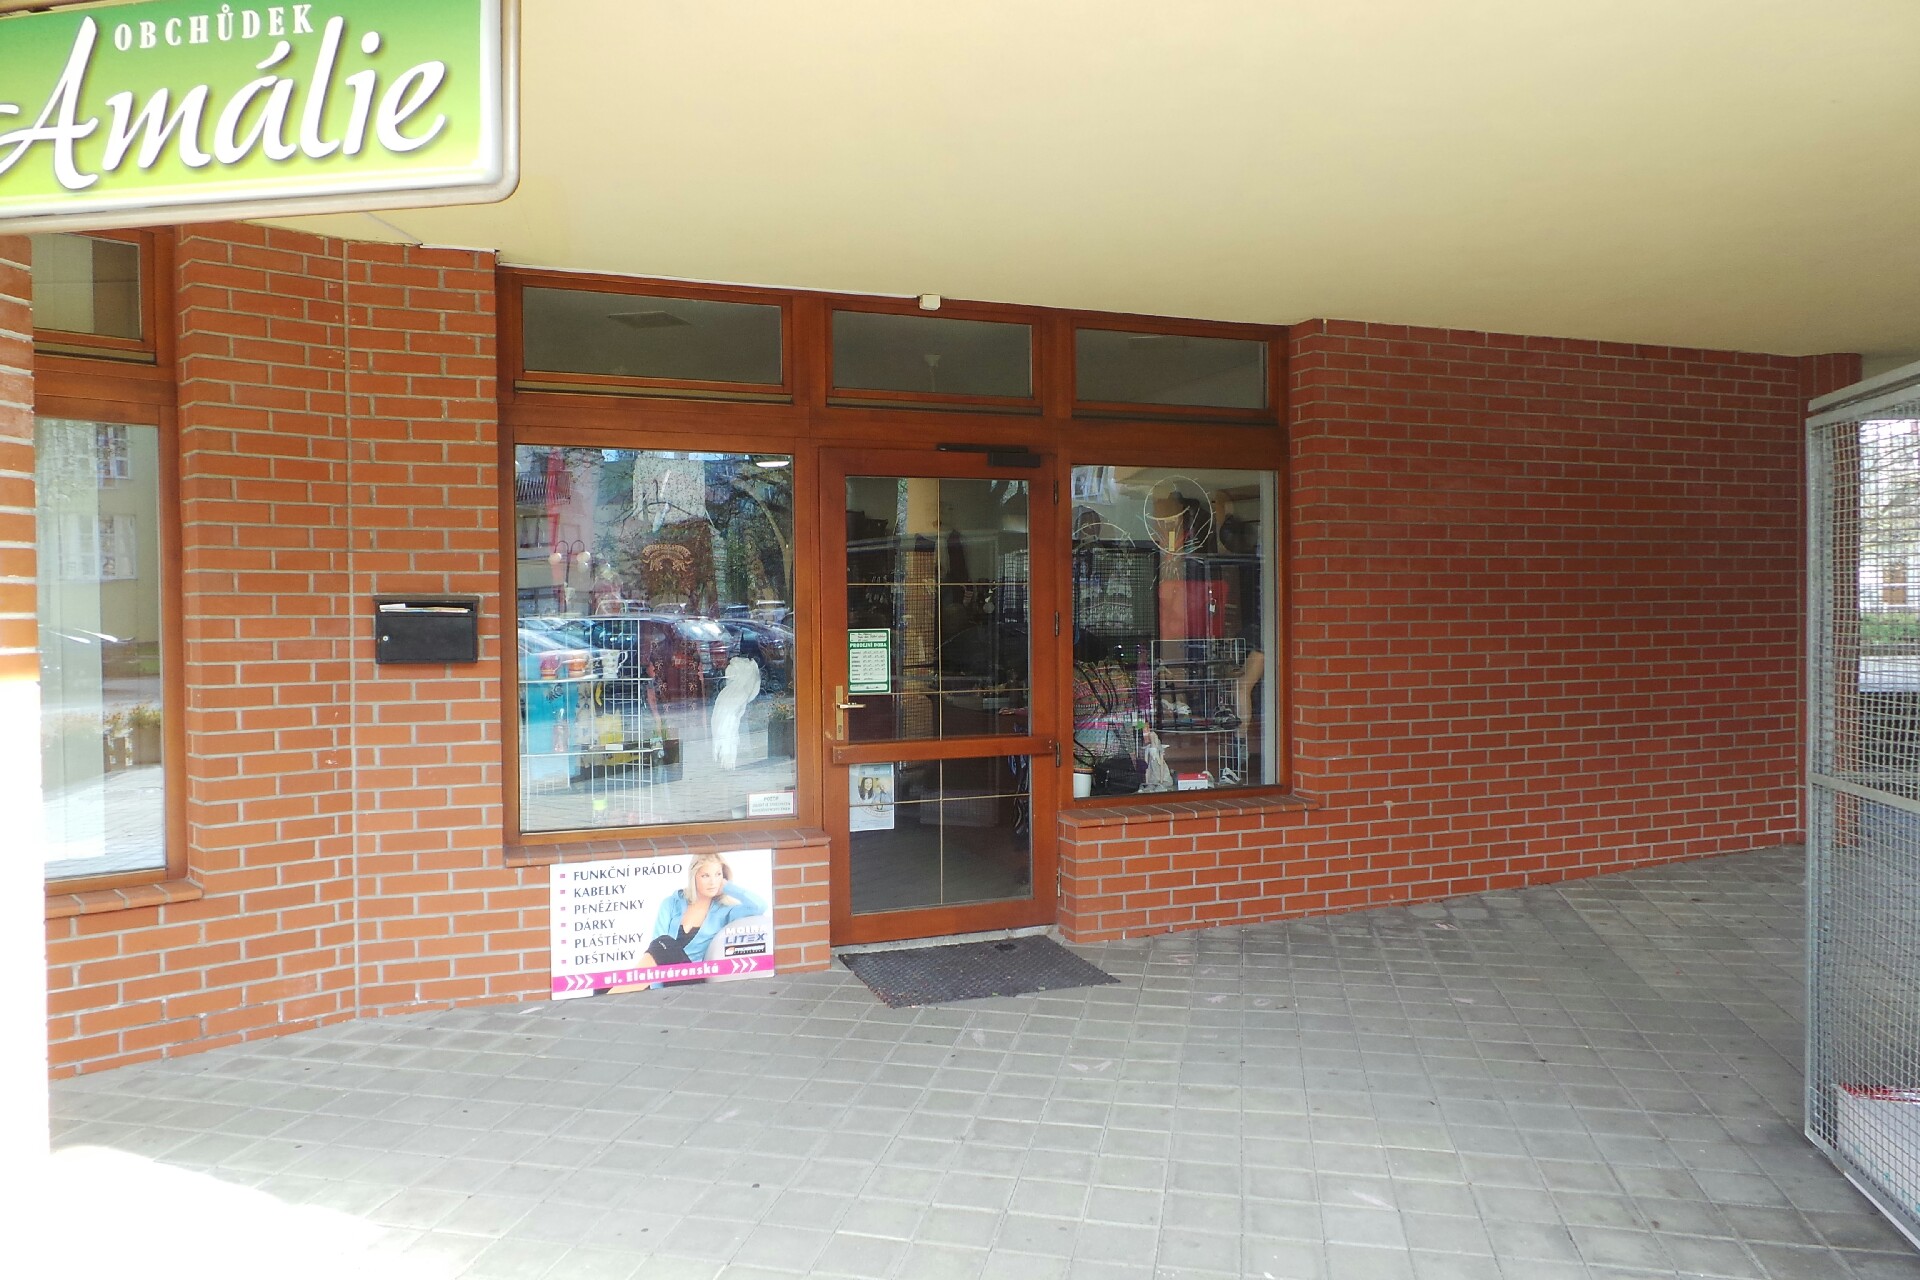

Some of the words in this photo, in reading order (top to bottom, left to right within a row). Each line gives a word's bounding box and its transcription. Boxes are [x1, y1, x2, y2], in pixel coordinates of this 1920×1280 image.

[115, 4, 314, 51] OBCHŮDEK
[0, 16, 446, 189] Amálie
[574, 865, 630, 881] FUNKČNÍ
[634, 863, 682, 876] PRÁDLO
[574, 885, 627, 898] KABELKY
[574, 899, 645, 915] PENĚŽENKY
[574, 917, 616, 932] DÁRKY
[574, 932, 644, 949] PLÁŠTĚNKY
[725, 933, 766, 944] LITEX
[575, 948, 636, 966] DEŠTNÍKY
[604, 972, 623, 985] ul.
[626, 963, 720, 982] Elektrárenská
